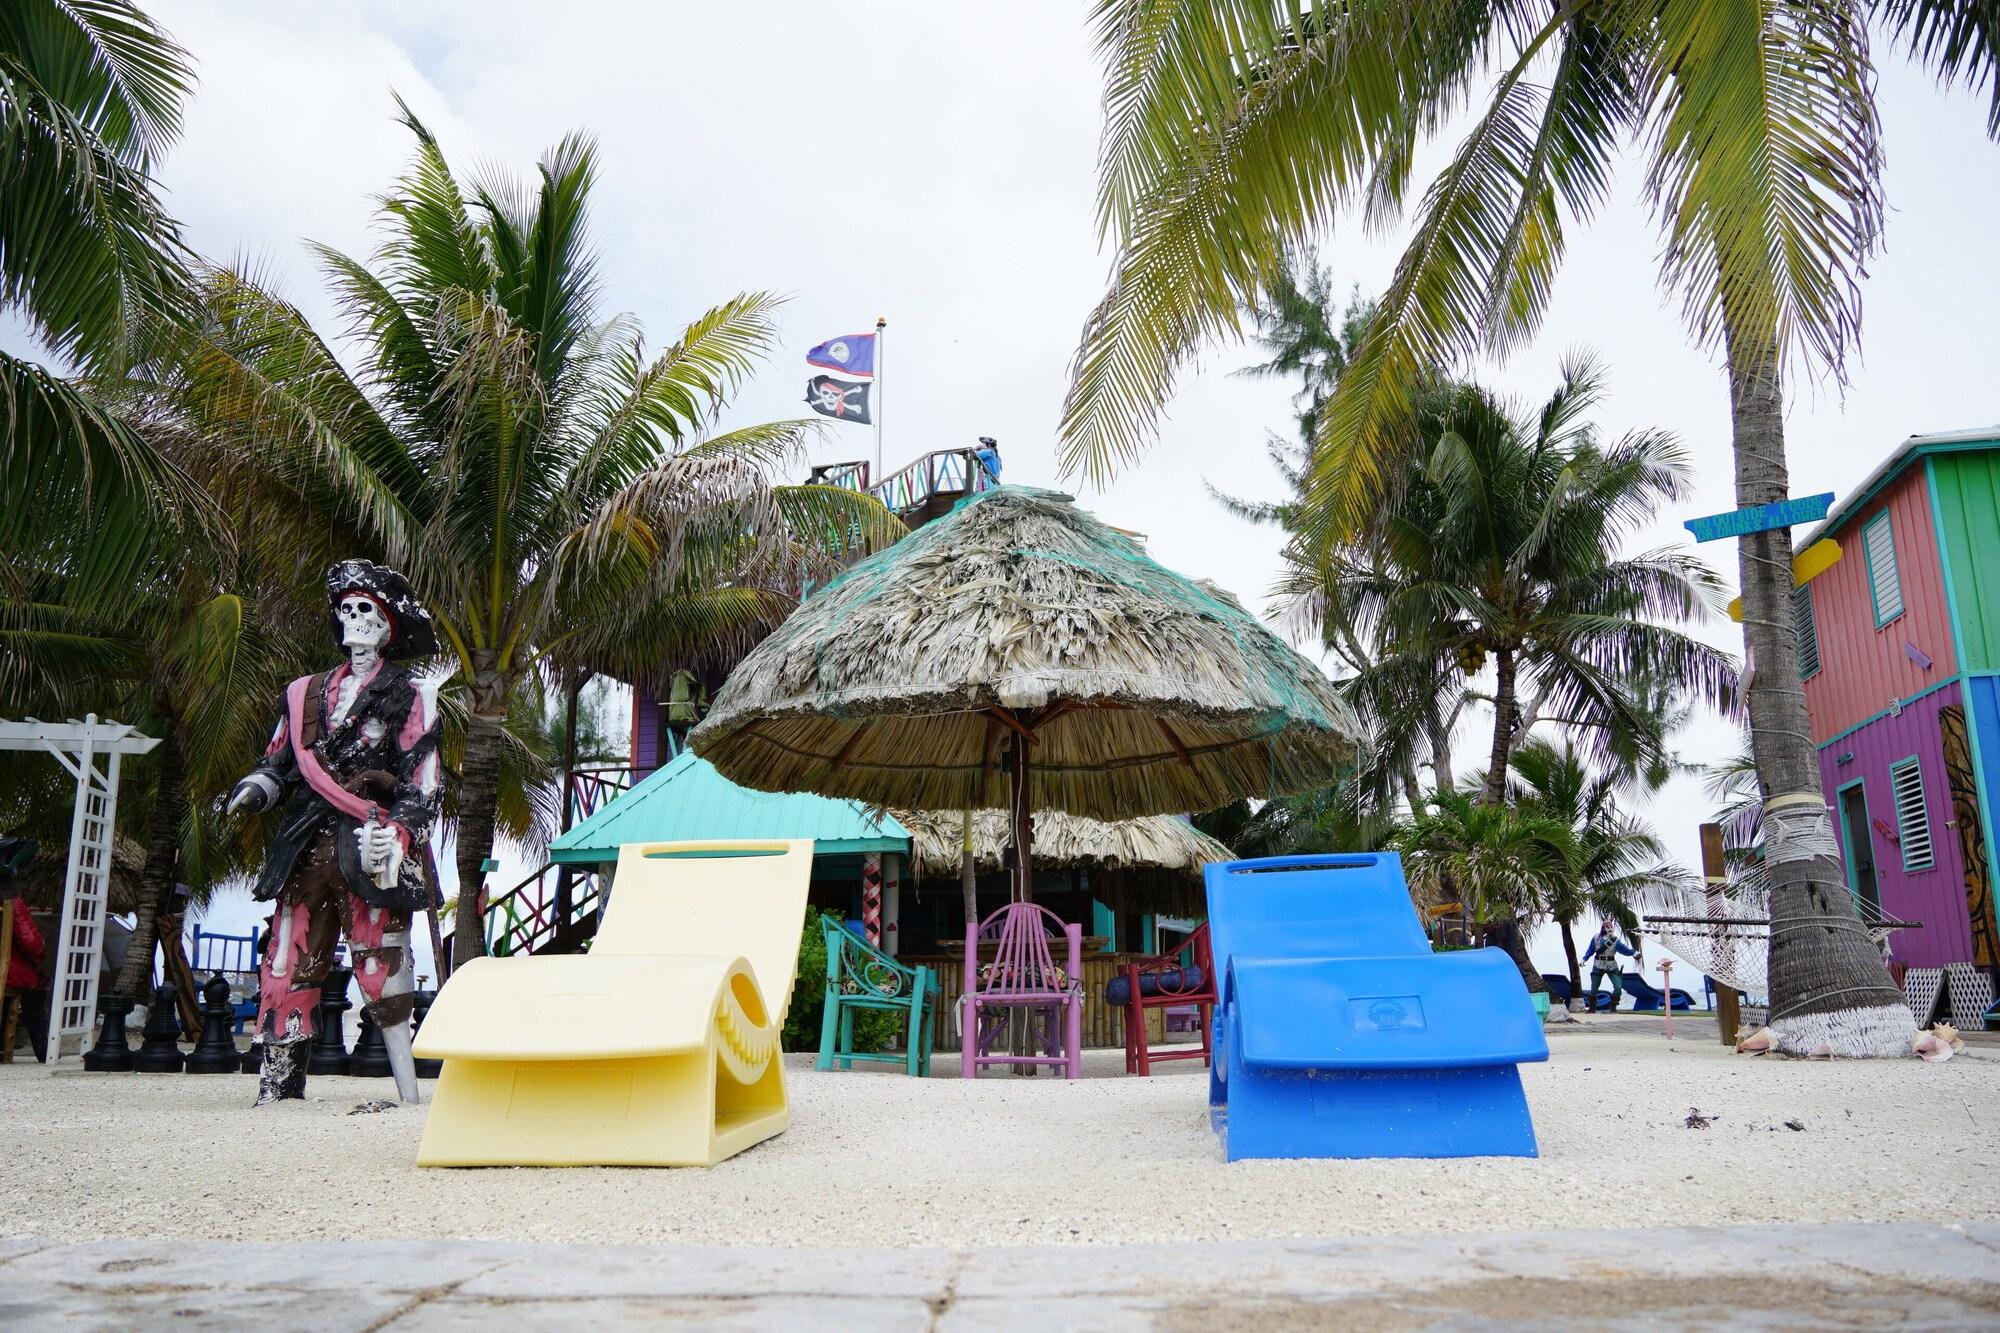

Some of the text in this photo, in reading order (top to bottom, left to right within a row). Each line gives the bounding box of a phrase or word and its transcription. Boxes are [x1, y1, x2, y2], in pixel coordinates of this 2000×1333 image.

[1697, 508, 1825, 541] OR DRINKS ALLOWED
[1713, 506, 1767, 526] OUTSIDE
[1779, 495, 1823, 513] FOODS
